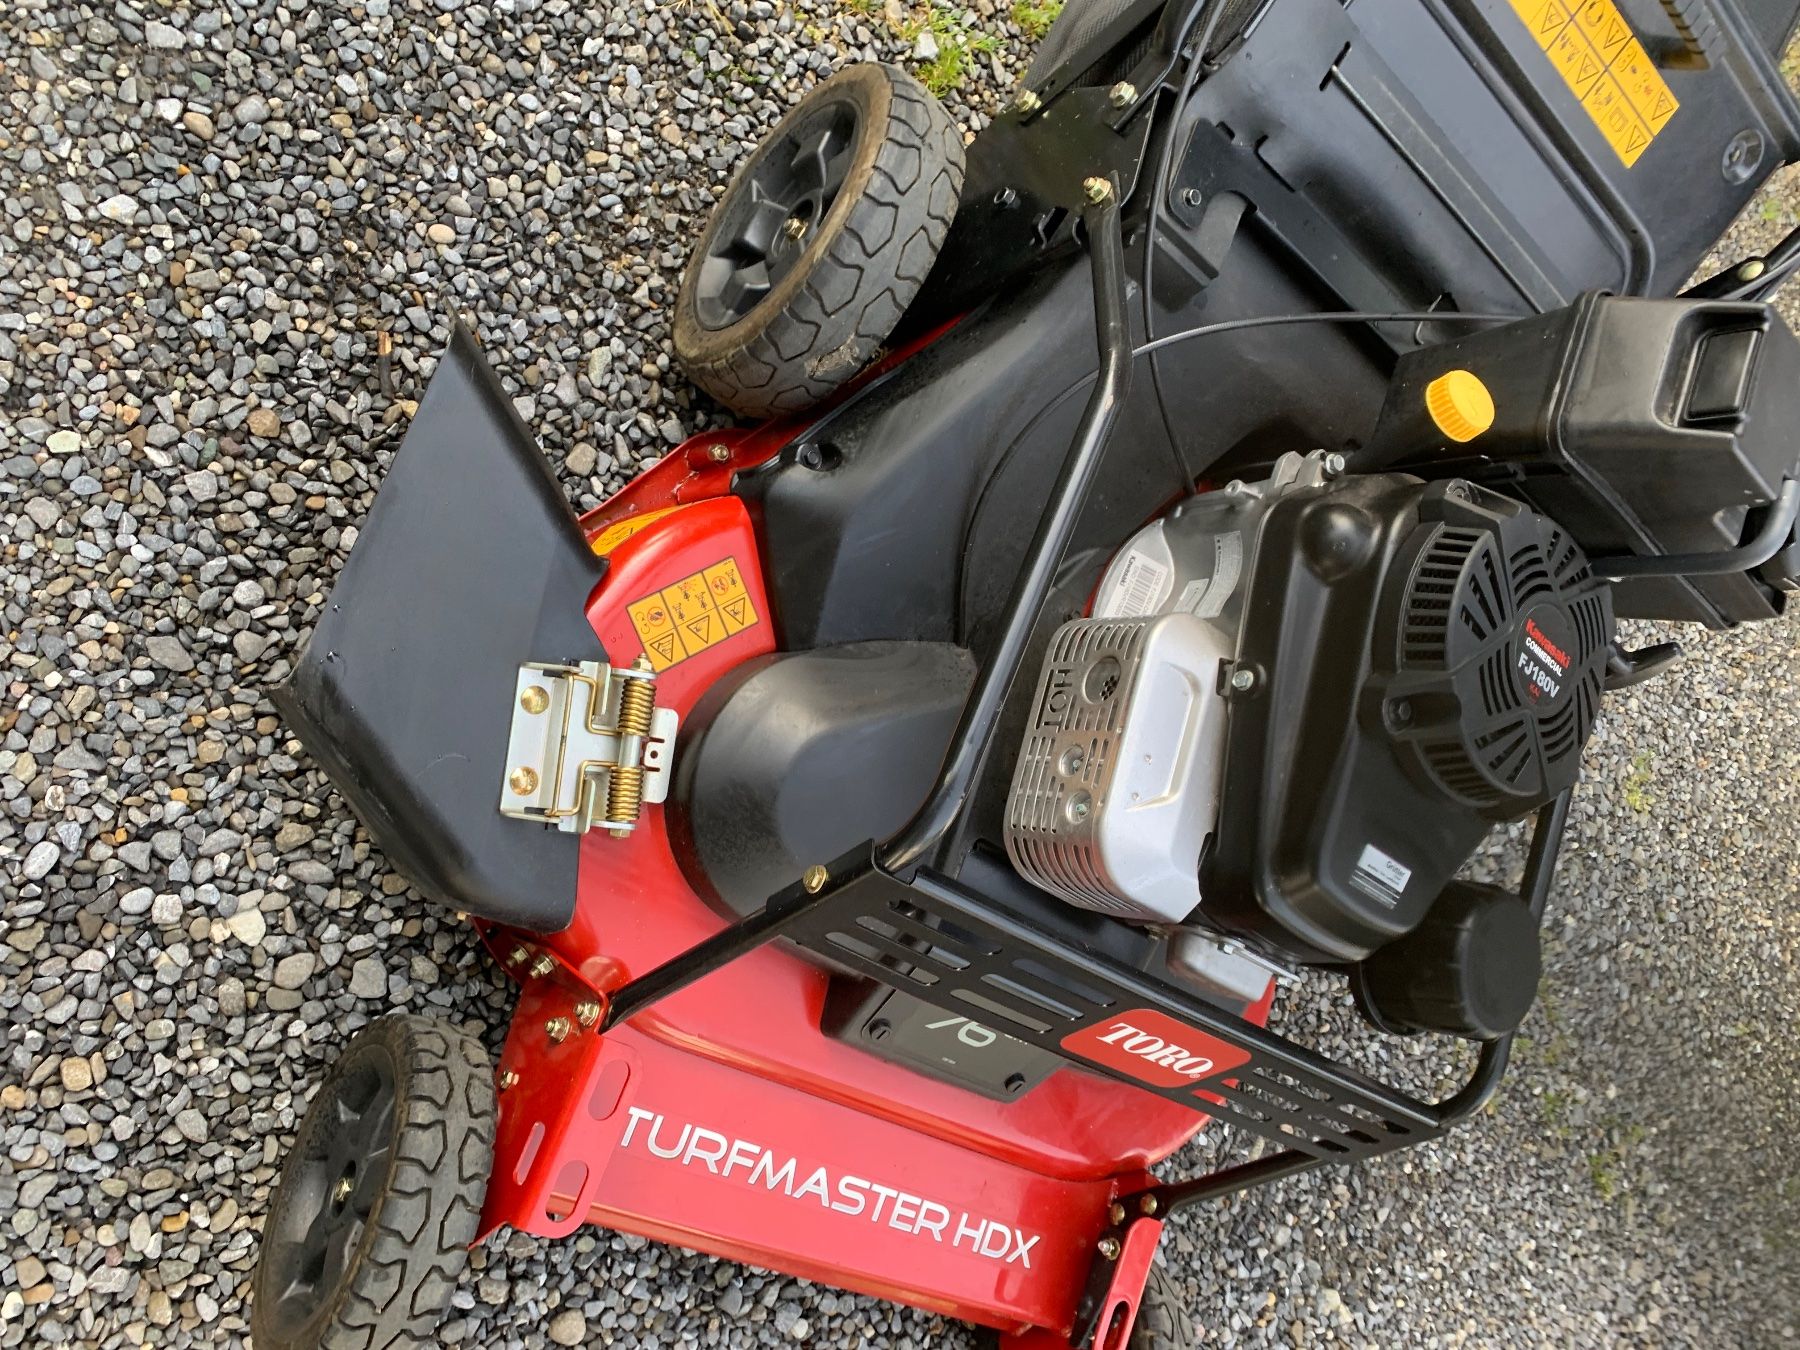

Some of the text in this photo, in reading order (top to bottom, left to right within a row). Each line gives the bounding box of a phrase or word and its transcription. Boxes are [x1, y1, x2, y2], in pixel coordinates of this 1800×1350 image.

[1525, 618, 1572, 669] Kawasaki
[1525, 637, 1563, 677] COMMERCIAL
[1042, 668, 1073, 734] HOT
[1518, 652, 1561, 699] FJ180V
[1096, 1022, 1214, 1077] TORO
[620, 1105, 1042, 1269] TURFMASTER HDX
